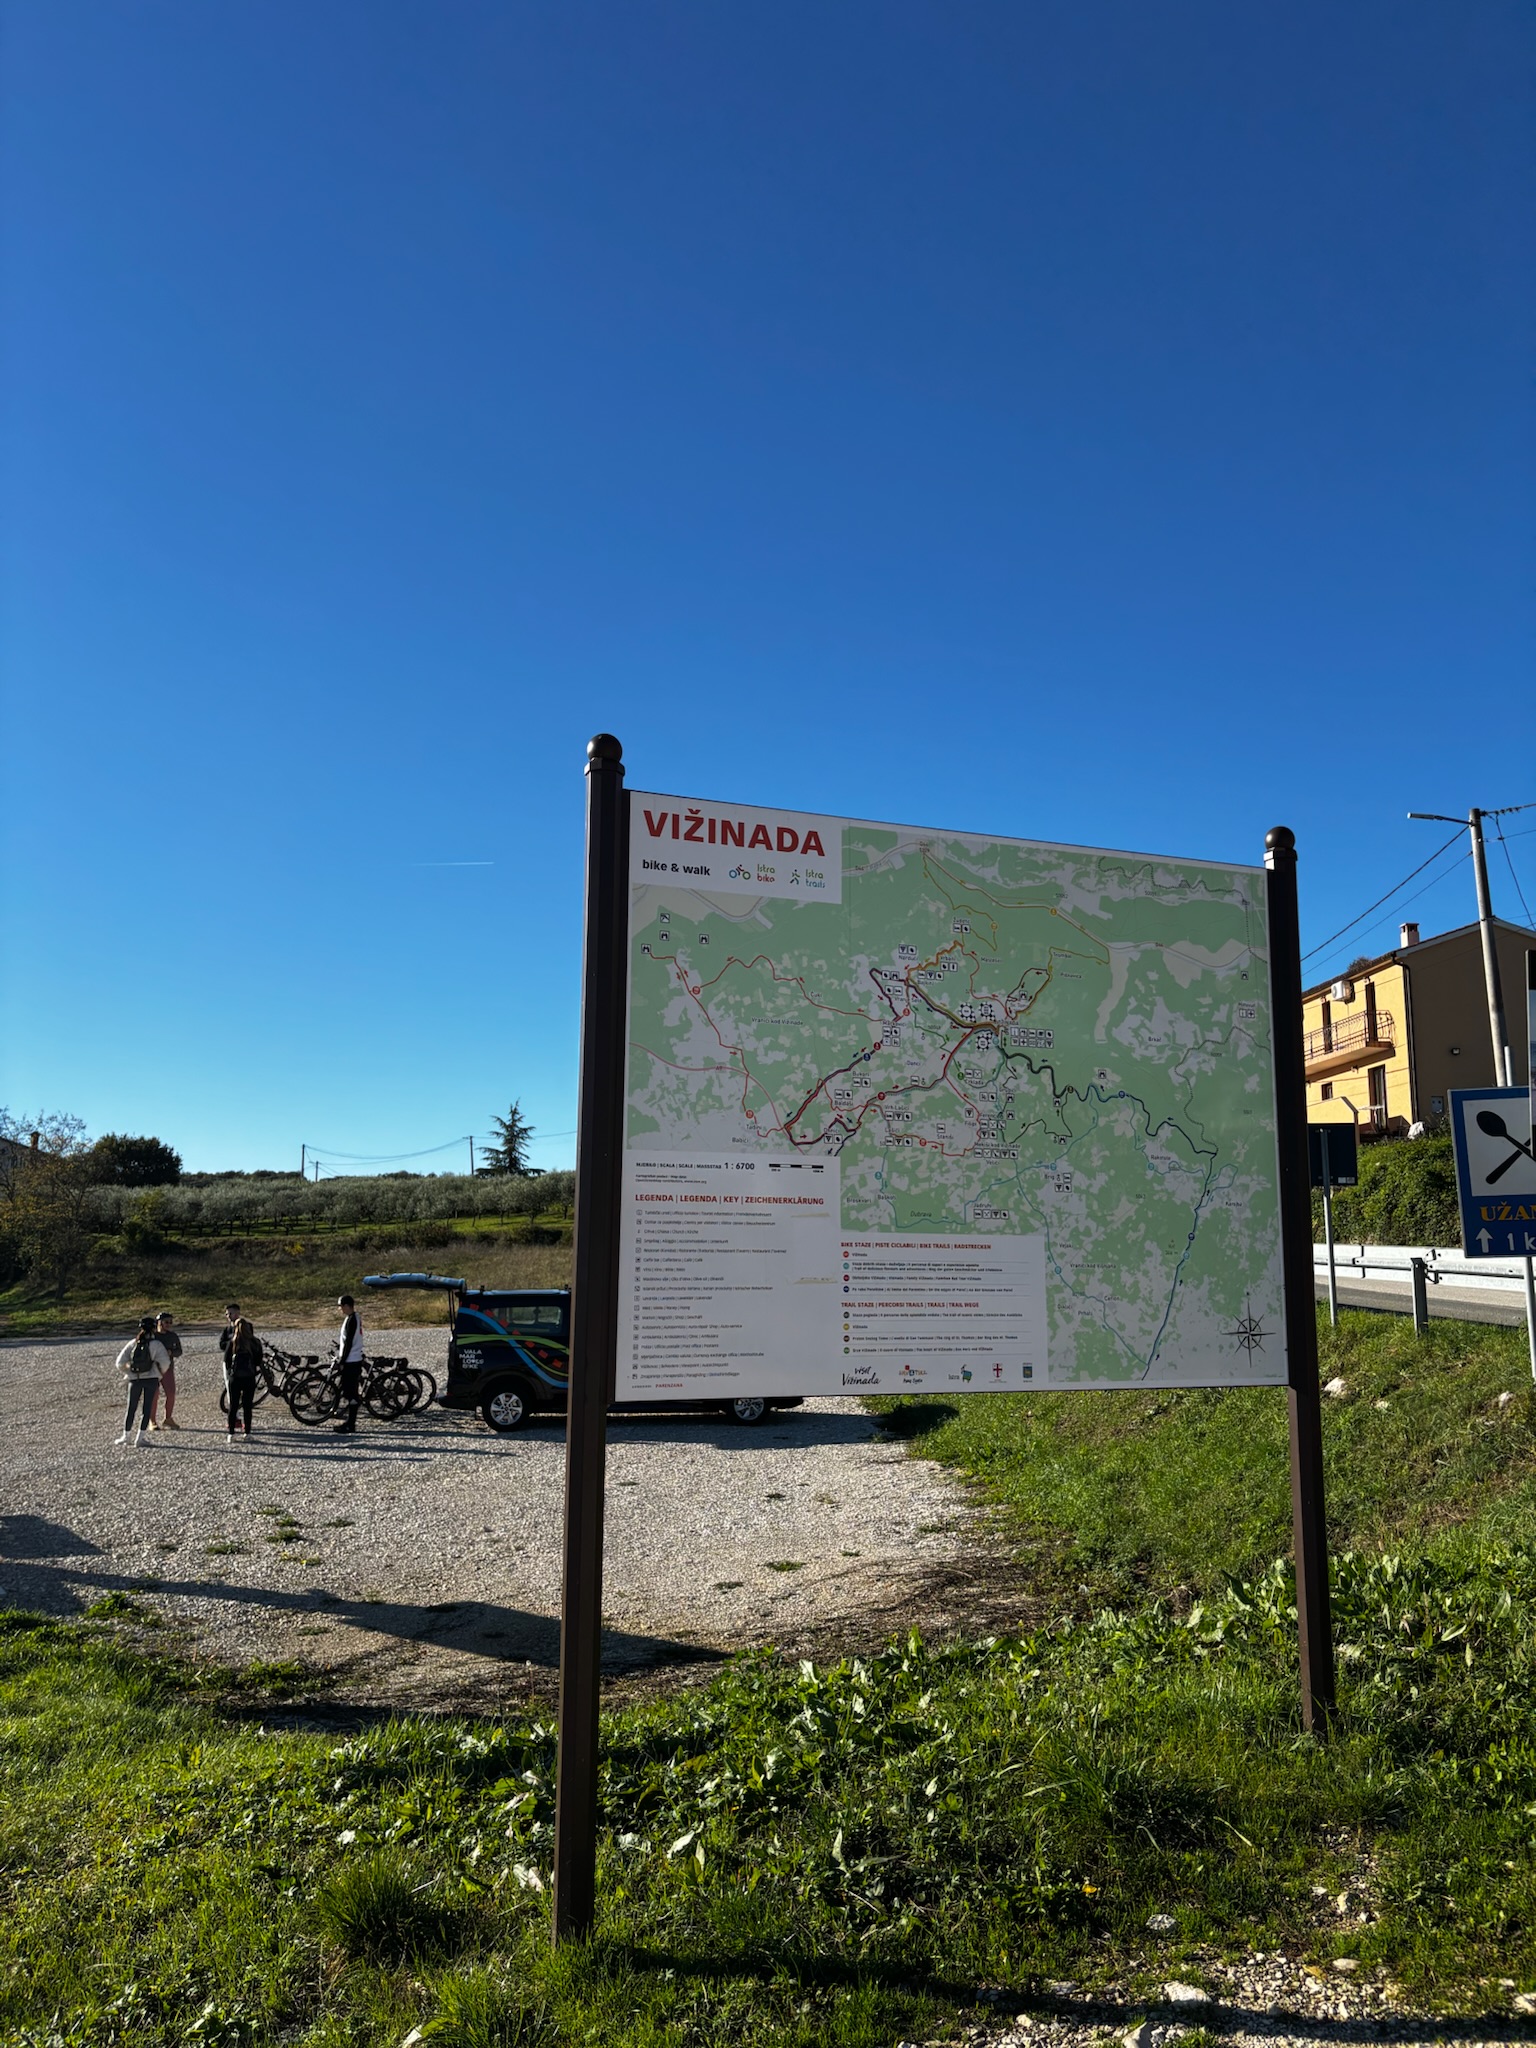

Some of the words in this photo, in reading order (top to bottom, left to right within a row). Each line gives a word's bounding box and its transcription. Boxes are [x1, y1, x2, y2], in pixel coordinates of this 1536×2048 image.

[643, 808, 826, 857] VIŽINADA
[643, 859, 667, 871] bike
[671, 863, 680, 873] &
[683, 865, 711, 877] walk
[757, 864, 776, 874] Istra
[806, 869, 824, 880] Istra
[724, 1162, 729, 1170] 1
[735, 1162, 756, 1171] 6700
[635, 1194, 674, 1202] LEGENDA
[679, 1194, 718, 1203] LEGENDA
[745, 1196, 825, 1206] ZEICHENERKLÄRUNG
[1507, 1232, 1515, 1251] 1
[854, 1364, 872, 1375] visit
